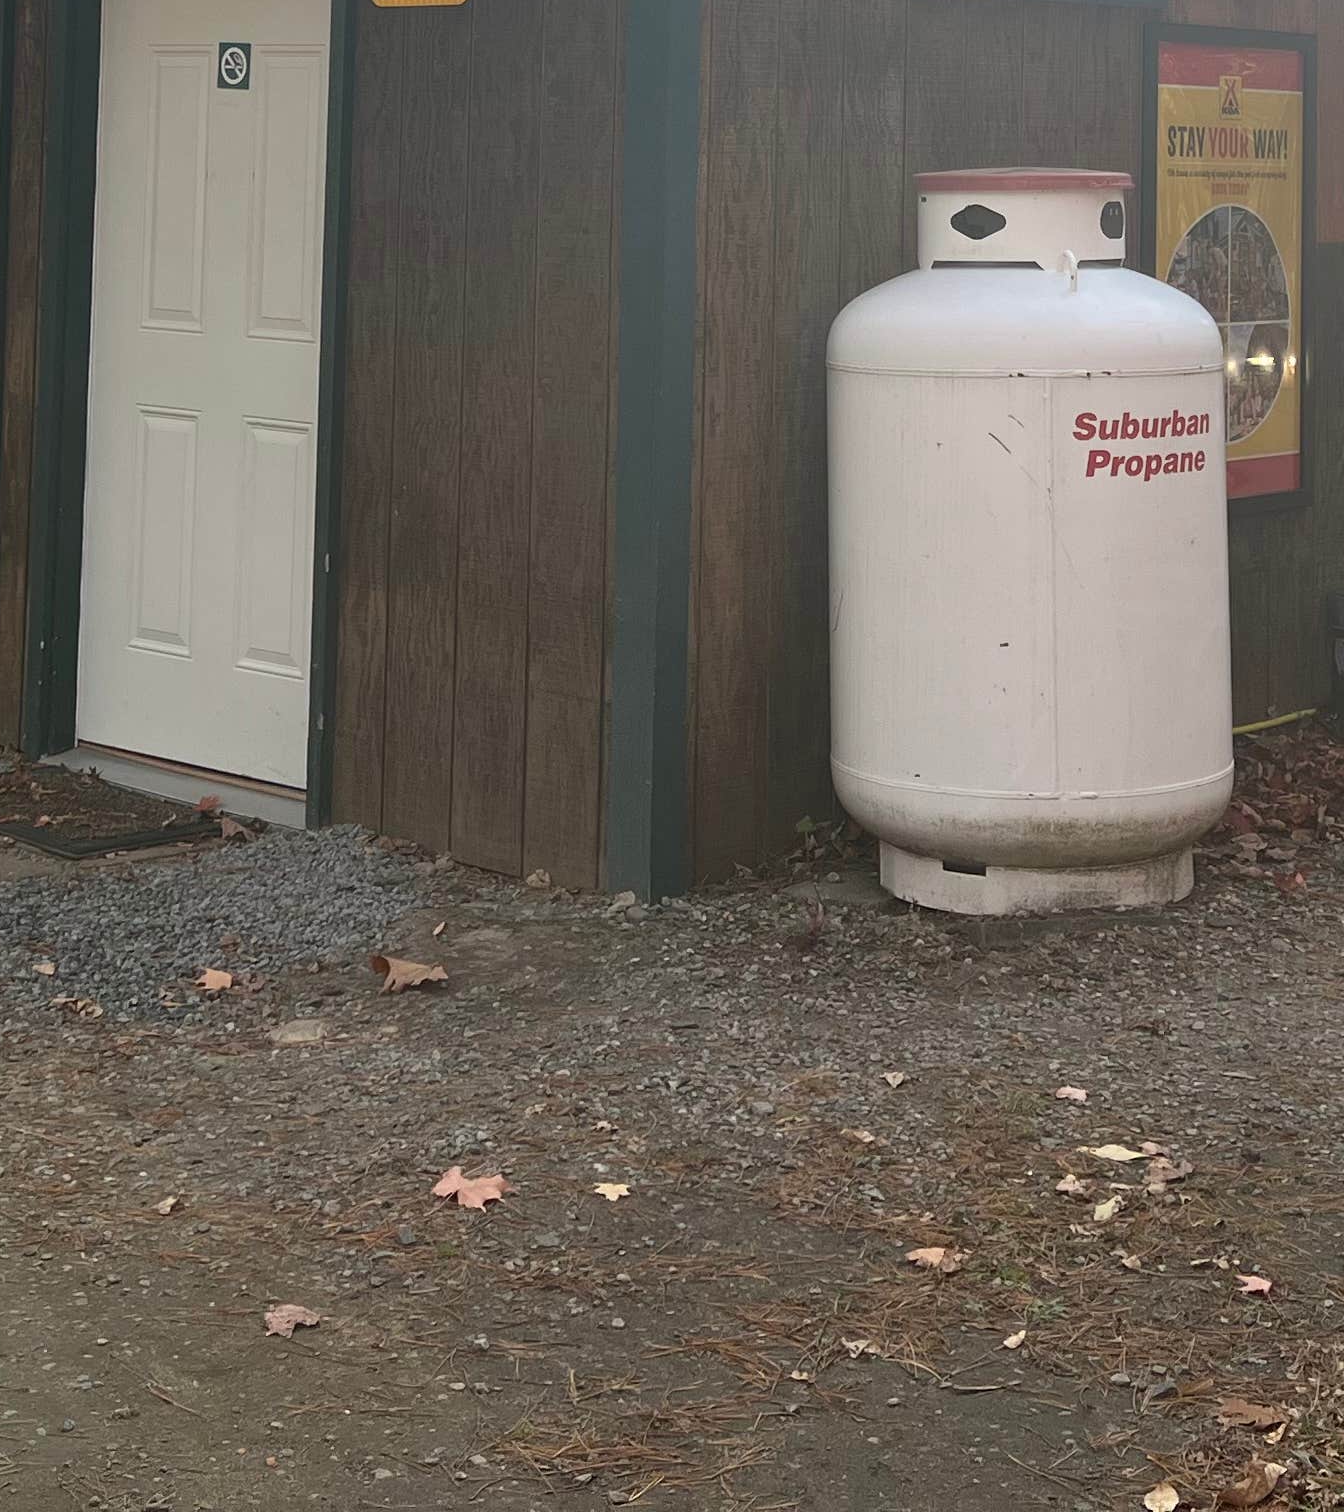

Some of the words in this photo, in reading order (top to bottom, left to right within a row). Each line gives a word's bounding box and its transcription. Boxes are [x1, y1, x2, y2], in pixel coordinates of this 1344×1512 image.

[1167, 125, 1206, 158] STAY
[1208, 127, 1250, 159] YOUR
[1253, 128, 1288, 160] WAY!
[1072, 408, 1210, 441] Suburban
[1085, 449, 1206, 482] Propane
